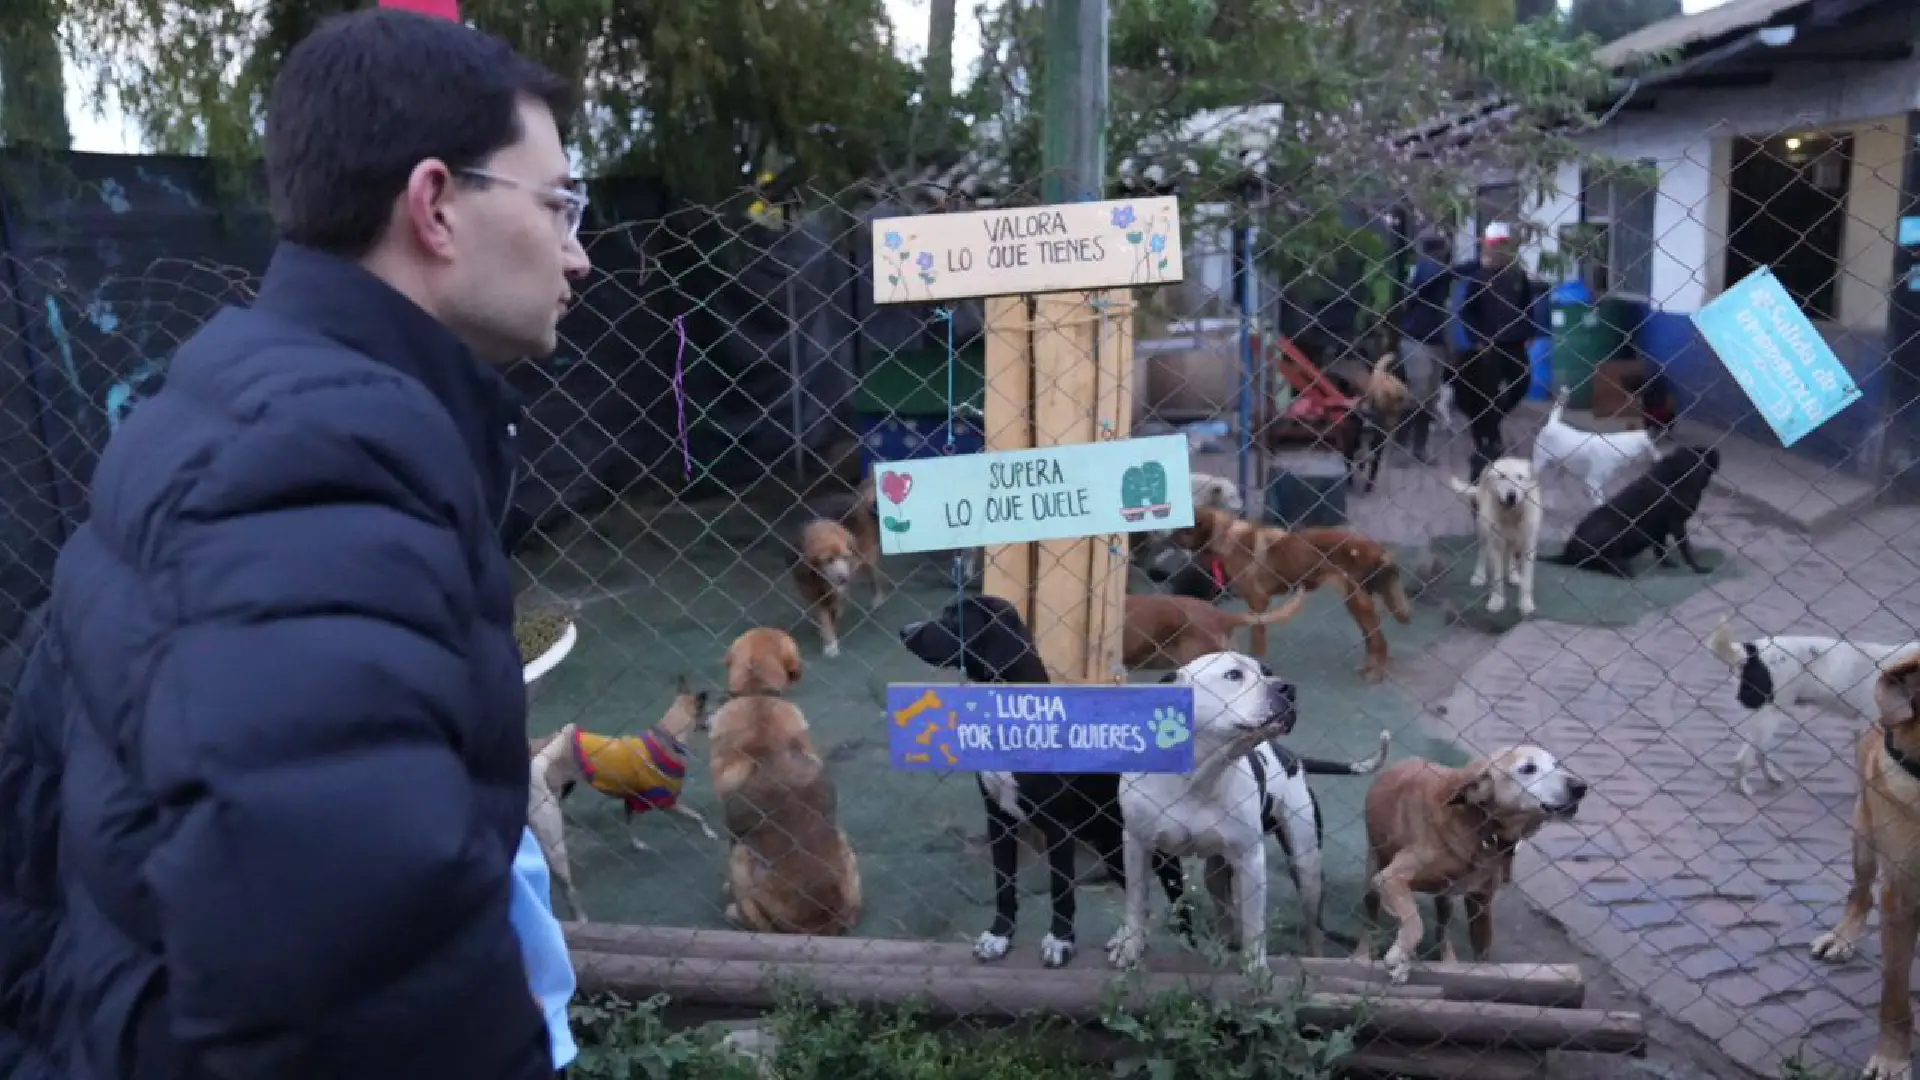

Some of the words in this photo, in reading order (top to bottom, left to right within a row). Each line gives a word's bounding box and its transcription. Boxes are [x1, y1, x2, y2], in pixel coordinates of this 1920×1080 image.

[984, 211, 1067, 241] VALORA
[947, 247, 973, 272] LO
[987, 244, 1028, 269] QUE
[1037, 235, 1105, 265] TIENES
[989, 458, 1065, 489] SUPERA
[945, 499, 972, 528] LO
[986, 495, 1024, 523] QUE
[1032, 489, 1092, 521] DUELE
[995, 694, 1067, 721] LUCHA
[957, 723, 993, 751] POR
[999, 724, 1022, 751] LO
[1025, 723, 1062, 750] QUE
[1068, 723, 1147, 753] QUIERES
